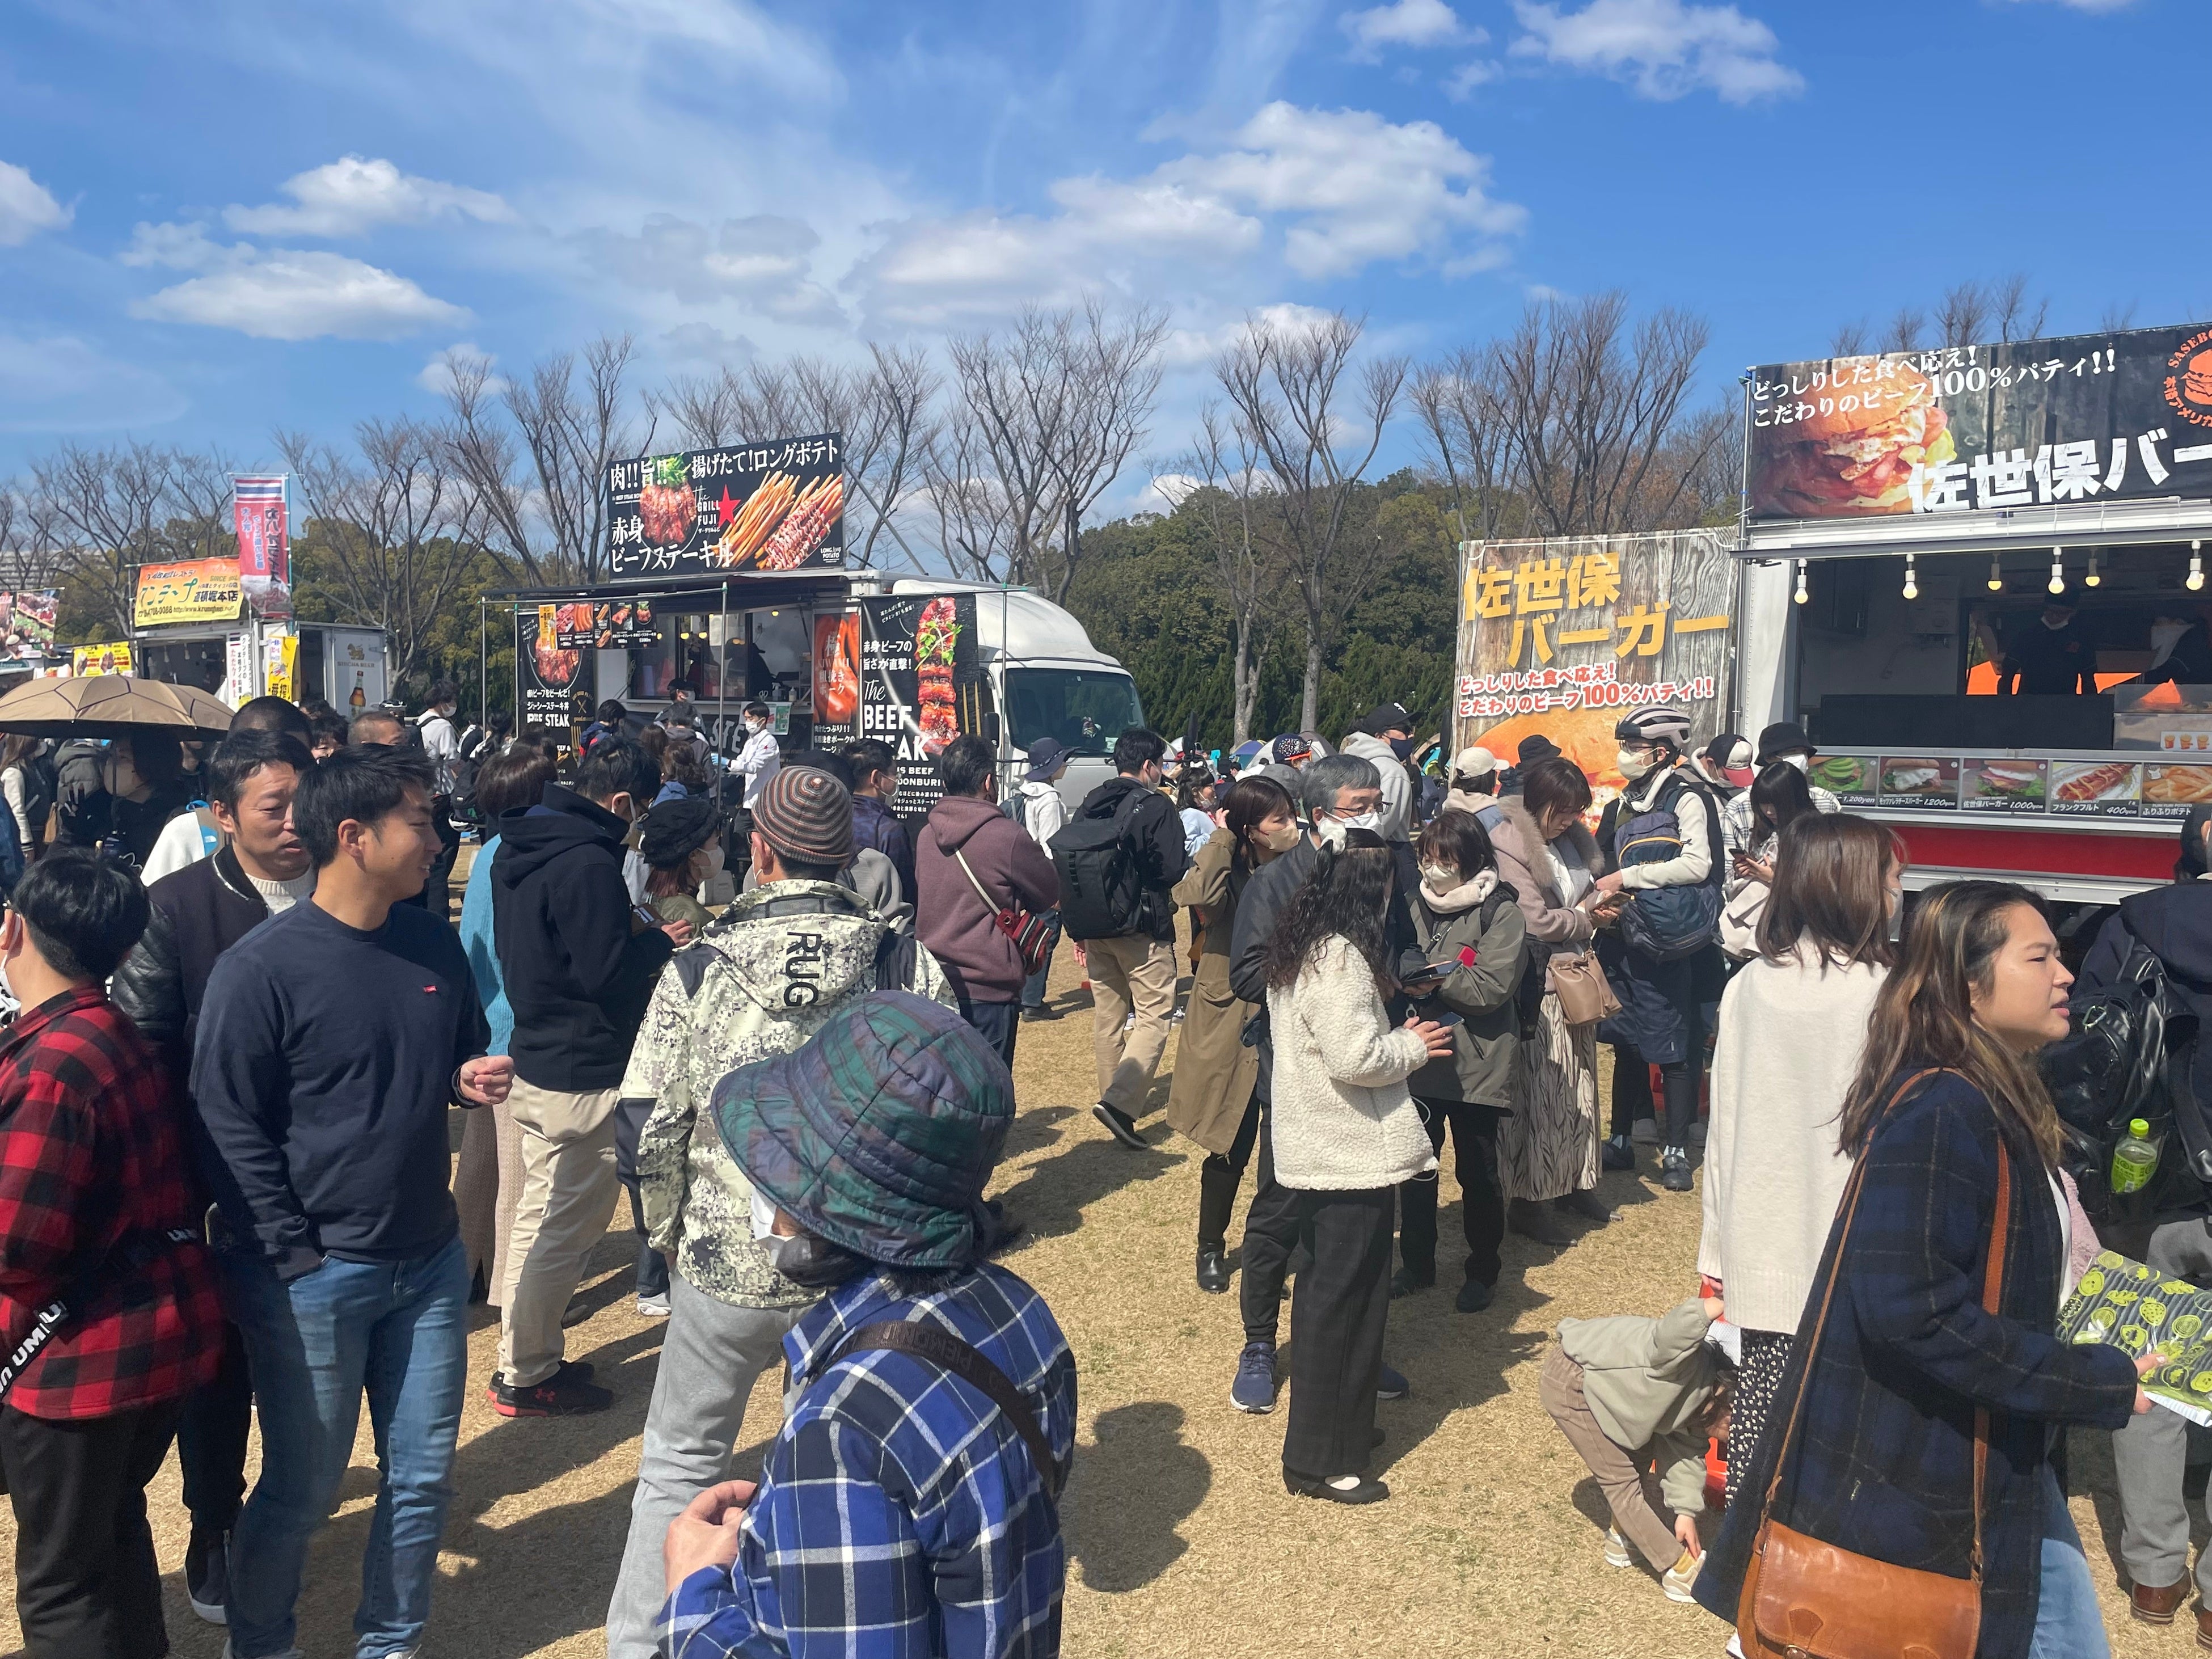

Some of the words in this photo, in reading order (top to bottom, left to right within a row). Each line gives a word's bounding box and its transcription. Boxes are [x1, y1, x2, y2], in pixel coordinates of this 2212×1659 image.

[1754, 345, 1977, 401] どっしりした食べ応え!
[1754, 349, 2116, 427] こだわりのビーフ100%パティ!!
[691, 438, 838, 479] 揚げたて!ロングポテト
[697, 500, 721, 512] GRILL
[698, 514, 717, 525] FUJI
[611, 515, 645, 546] 赤身
[611, 537, 733, 573] ビーフステーキ丼
[1464, 552, 1622, 621] 佐世保
[863, 640, 913, 653] 赤身ビーフの
[1506, 600, 1730, 669] バーガー
[863, 658, 912, 671] 旨さが直撃!
[1459, 661, 1617, 696] どっしりした食べ応え!
[864, 679, 886, 701] The
[1458, 676, 1716, 718] こだわりのビーフ100%パティ!!
[545, 713, 570, 728] STEAK
[864, 704, 913, 730] BEEF
[1963, 800, 2008, 808] 佐世保バーガー
[2053, 804, 2100, 812] フランクフルト
[2142, 807, 2192, 816] ふりふりポテト
[783, 931, 822, 1007] RUG
